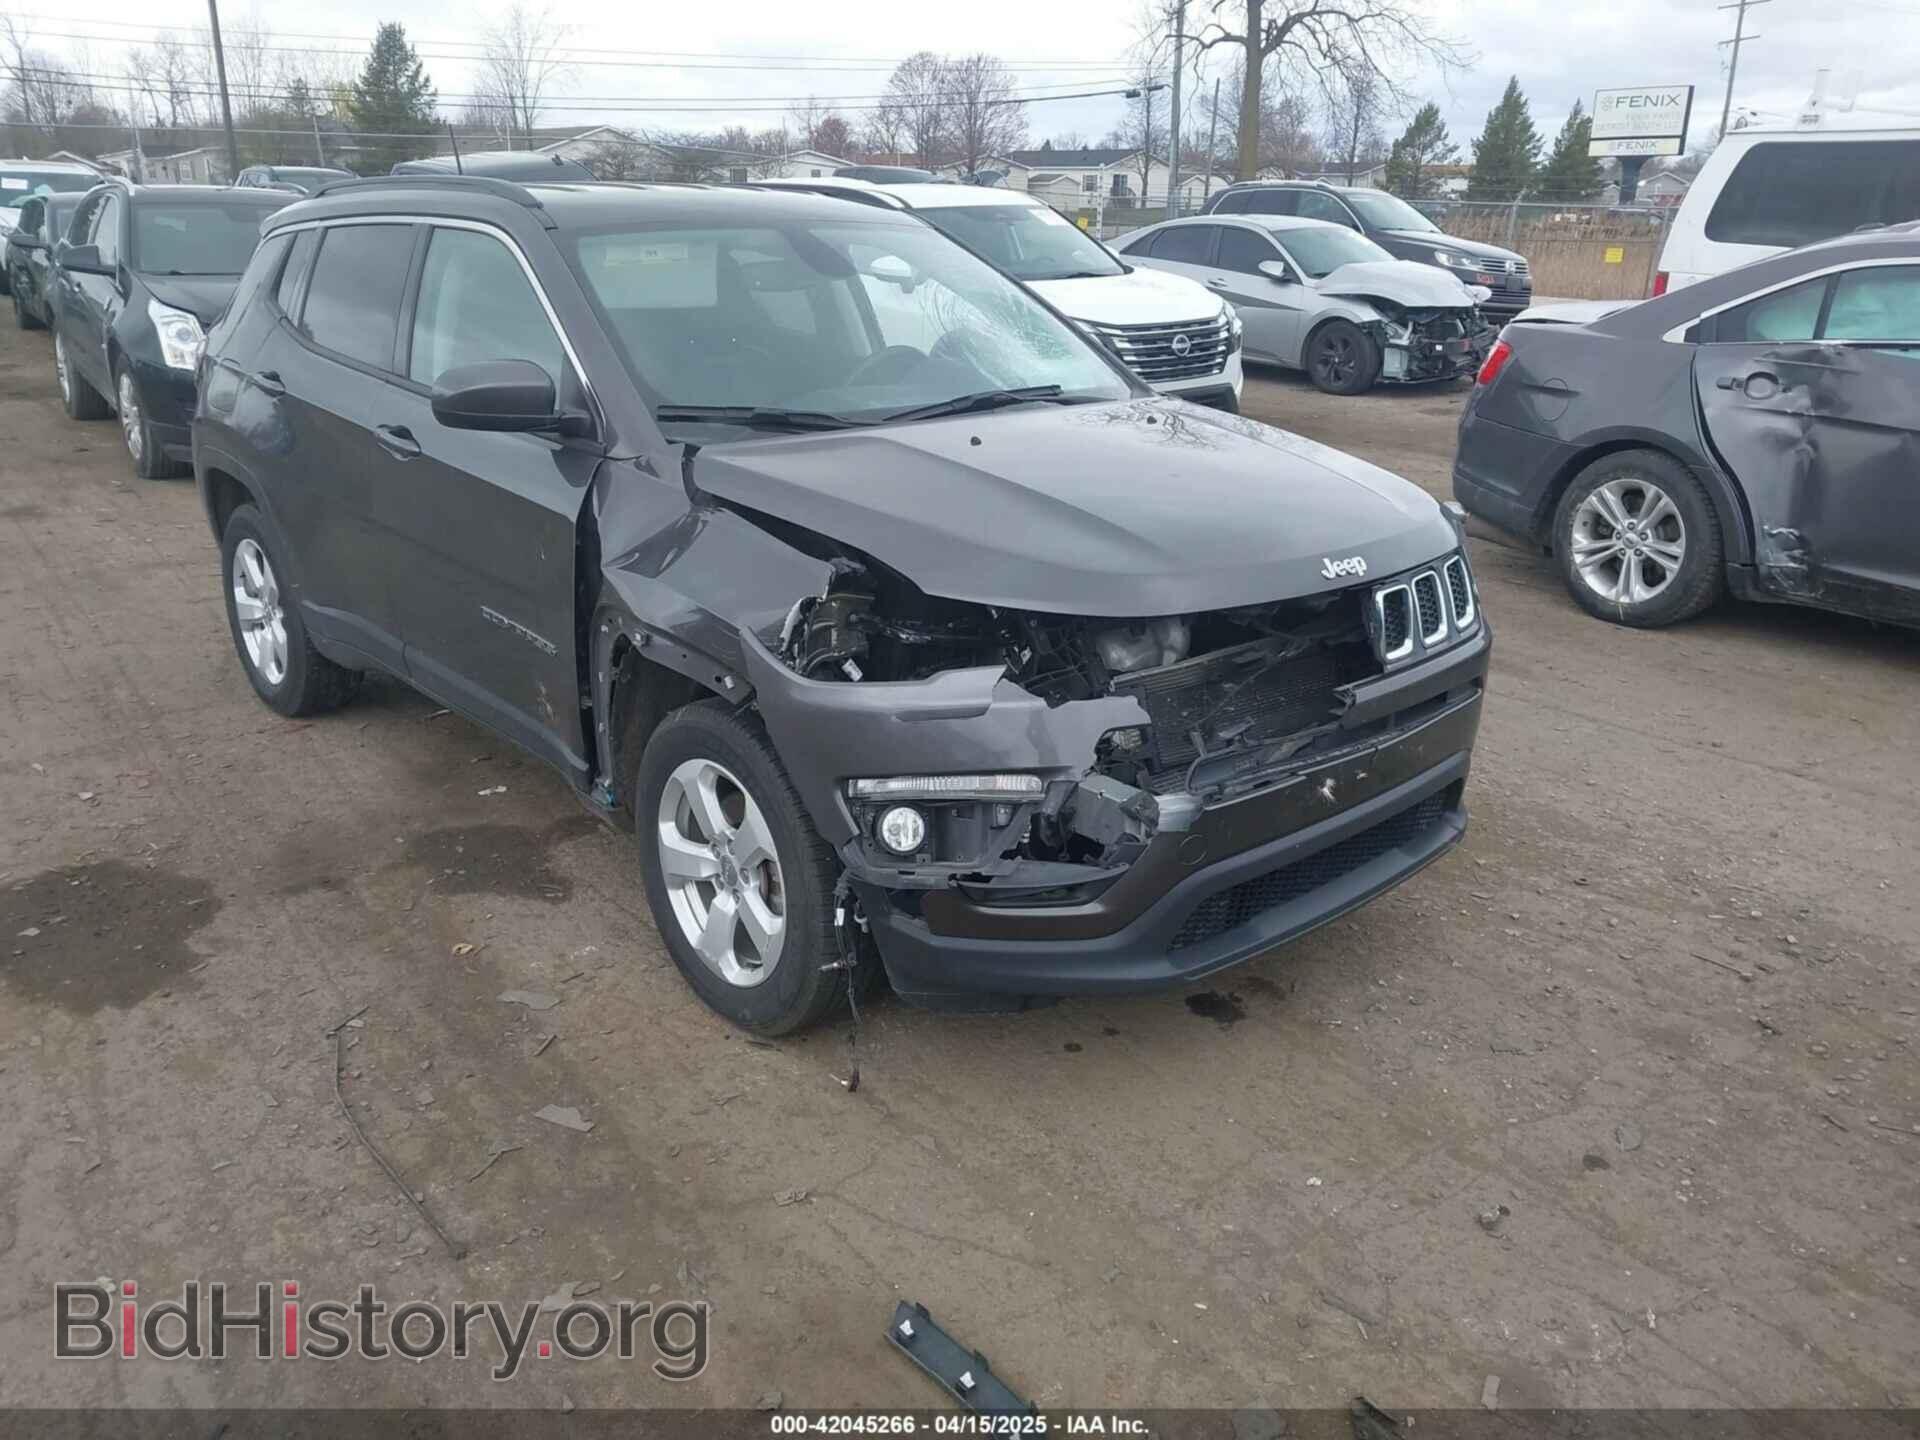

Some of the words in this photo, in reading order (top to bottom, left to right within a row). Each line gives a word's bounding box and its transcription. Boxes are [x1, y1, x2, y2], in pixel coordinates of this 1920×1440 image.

[1615, 93, 1681, 109] FENIX
[1616, 140, 1657, 151] FENIX
[1320, 555, 1368, 580] Jeep
